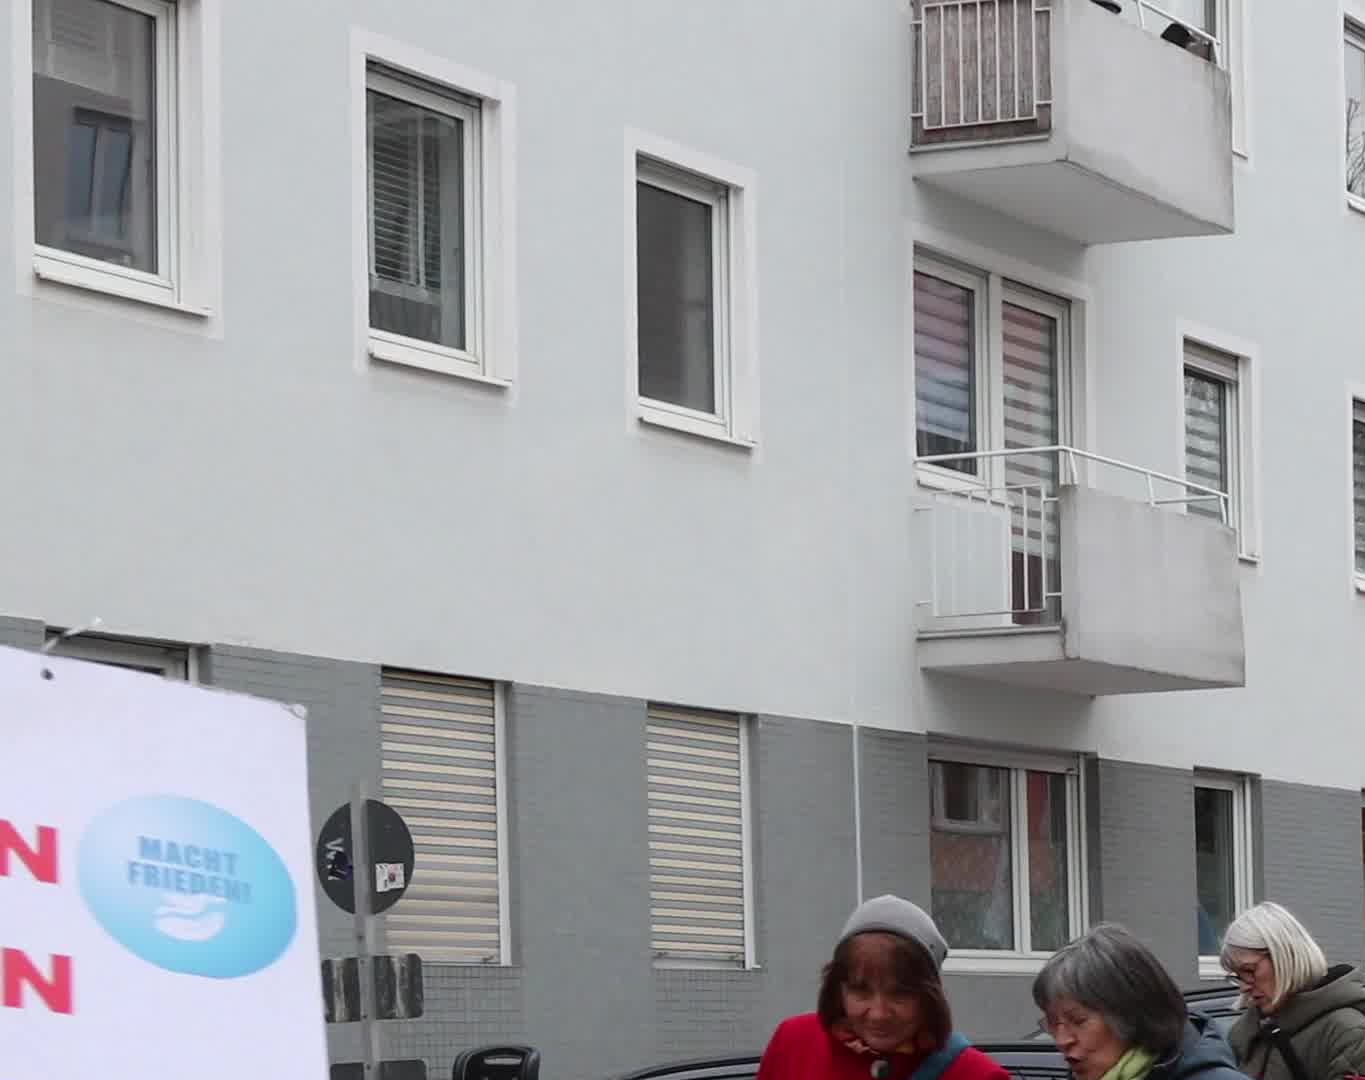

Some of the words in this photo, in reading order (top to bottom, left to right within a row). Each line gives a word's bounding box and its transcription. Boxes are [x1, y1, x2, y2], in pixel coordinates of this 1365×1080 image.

[0, 819, 59, 884] N
[137, 836, 240, 876] MACHT
[126, 861, 254, 904] FRIEDEN!
[1, 947, 73, 1015] N
